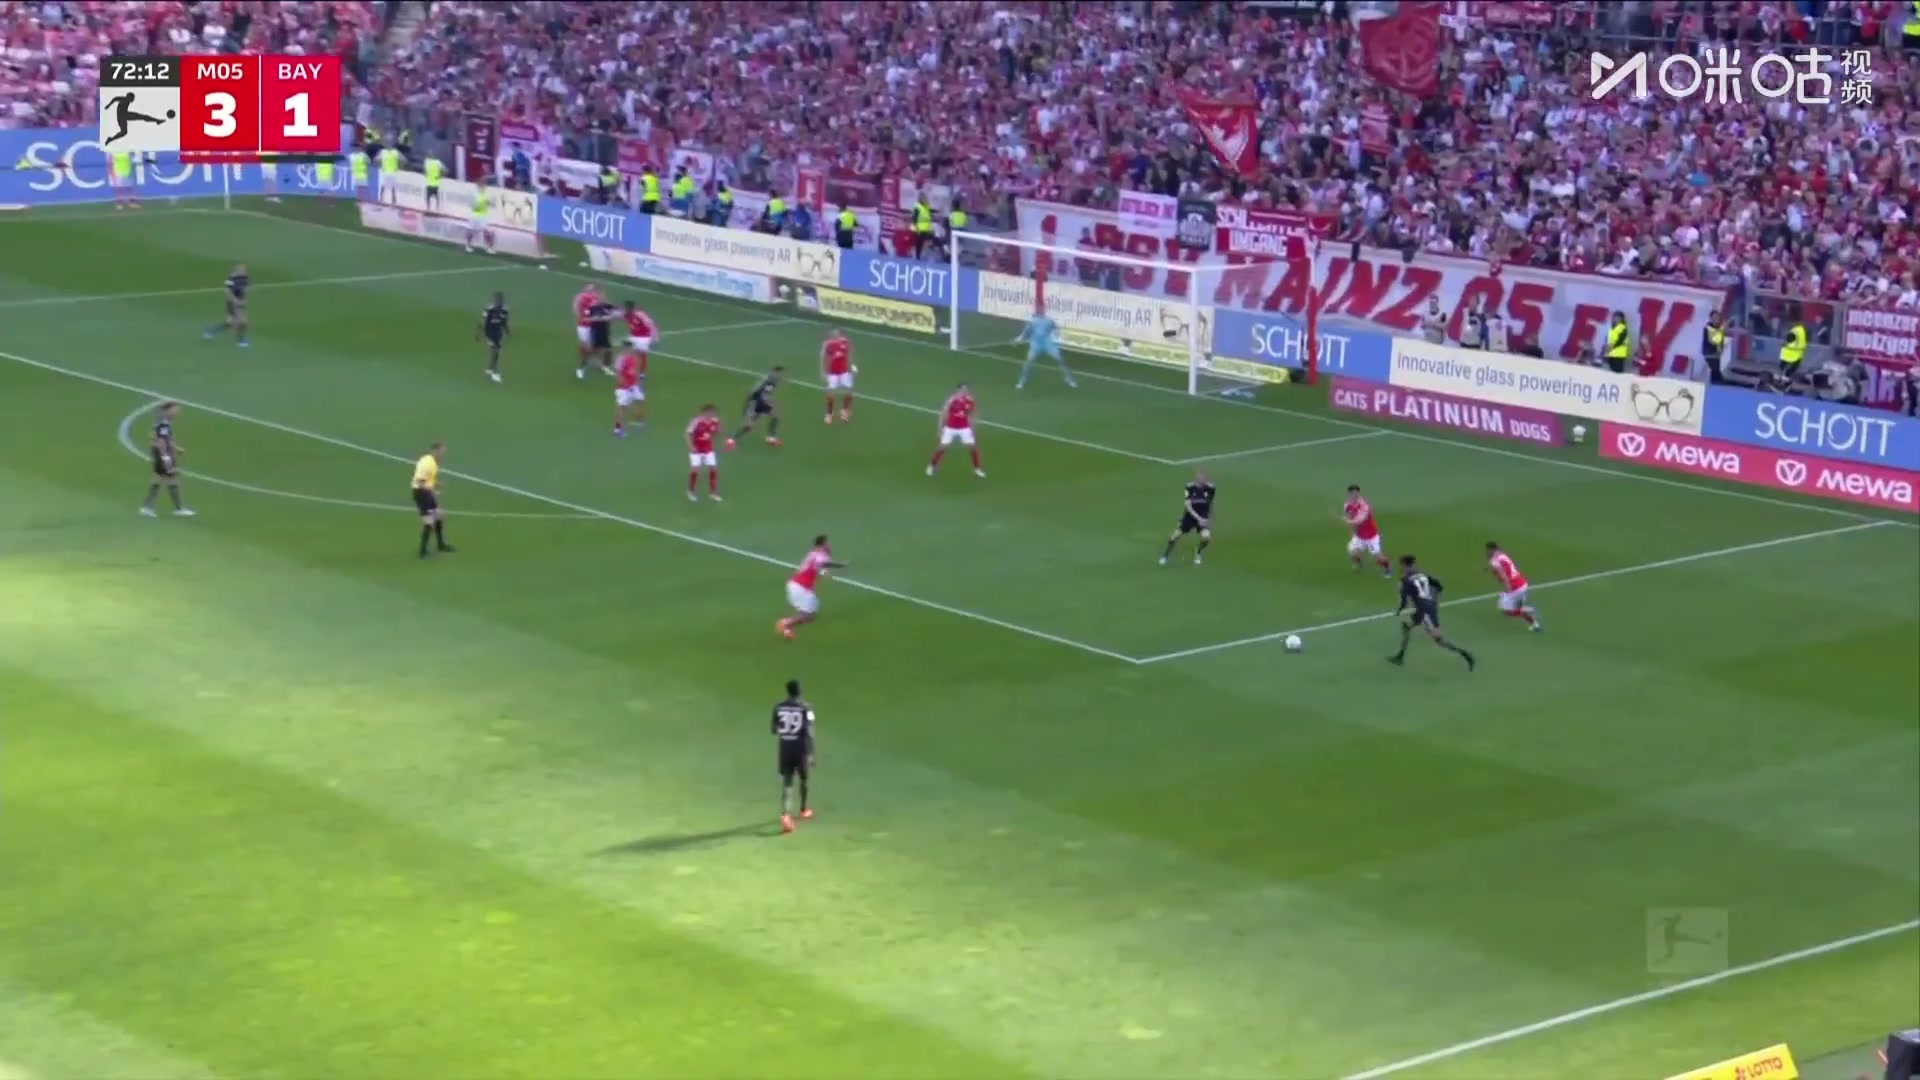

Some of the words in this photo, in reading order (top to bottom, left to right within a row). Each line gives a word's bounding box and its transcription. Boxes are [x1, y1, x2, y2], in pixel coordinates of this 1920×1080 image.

[561, 205, 627, 242] SCHOTT
[1229, 228, 1288, 256] UMGANG
[777, 247, 792, 263] AR
[869, 258, 948, 298] SCHOTT
[1076, 302, 1132, 327] powering
[1135, 308, 1151, 327] AR
[1213, 248, 1442, 330] MAINZ
[1447, 275, 1557, 352] 05
[1251, 322, 1351, 369] SCHOTT
[1397, 351, 1472, 379] Innovative
[1475, 365, 1515, 386] glass
[1519, 374, 1592, 404] powering
[1597, 384, 1620, 403] AR
[1334, 388, 1368, 411] CATS
[1373, 389, 1505, 434] PLATINUM
[1510, 418, 1551, 442] DOGS
[1754, 402, 1897, 457] SCHOTT
[777, 710, 803, 734] 39
[1747, 1056, 1783, 1078] LOTTO
